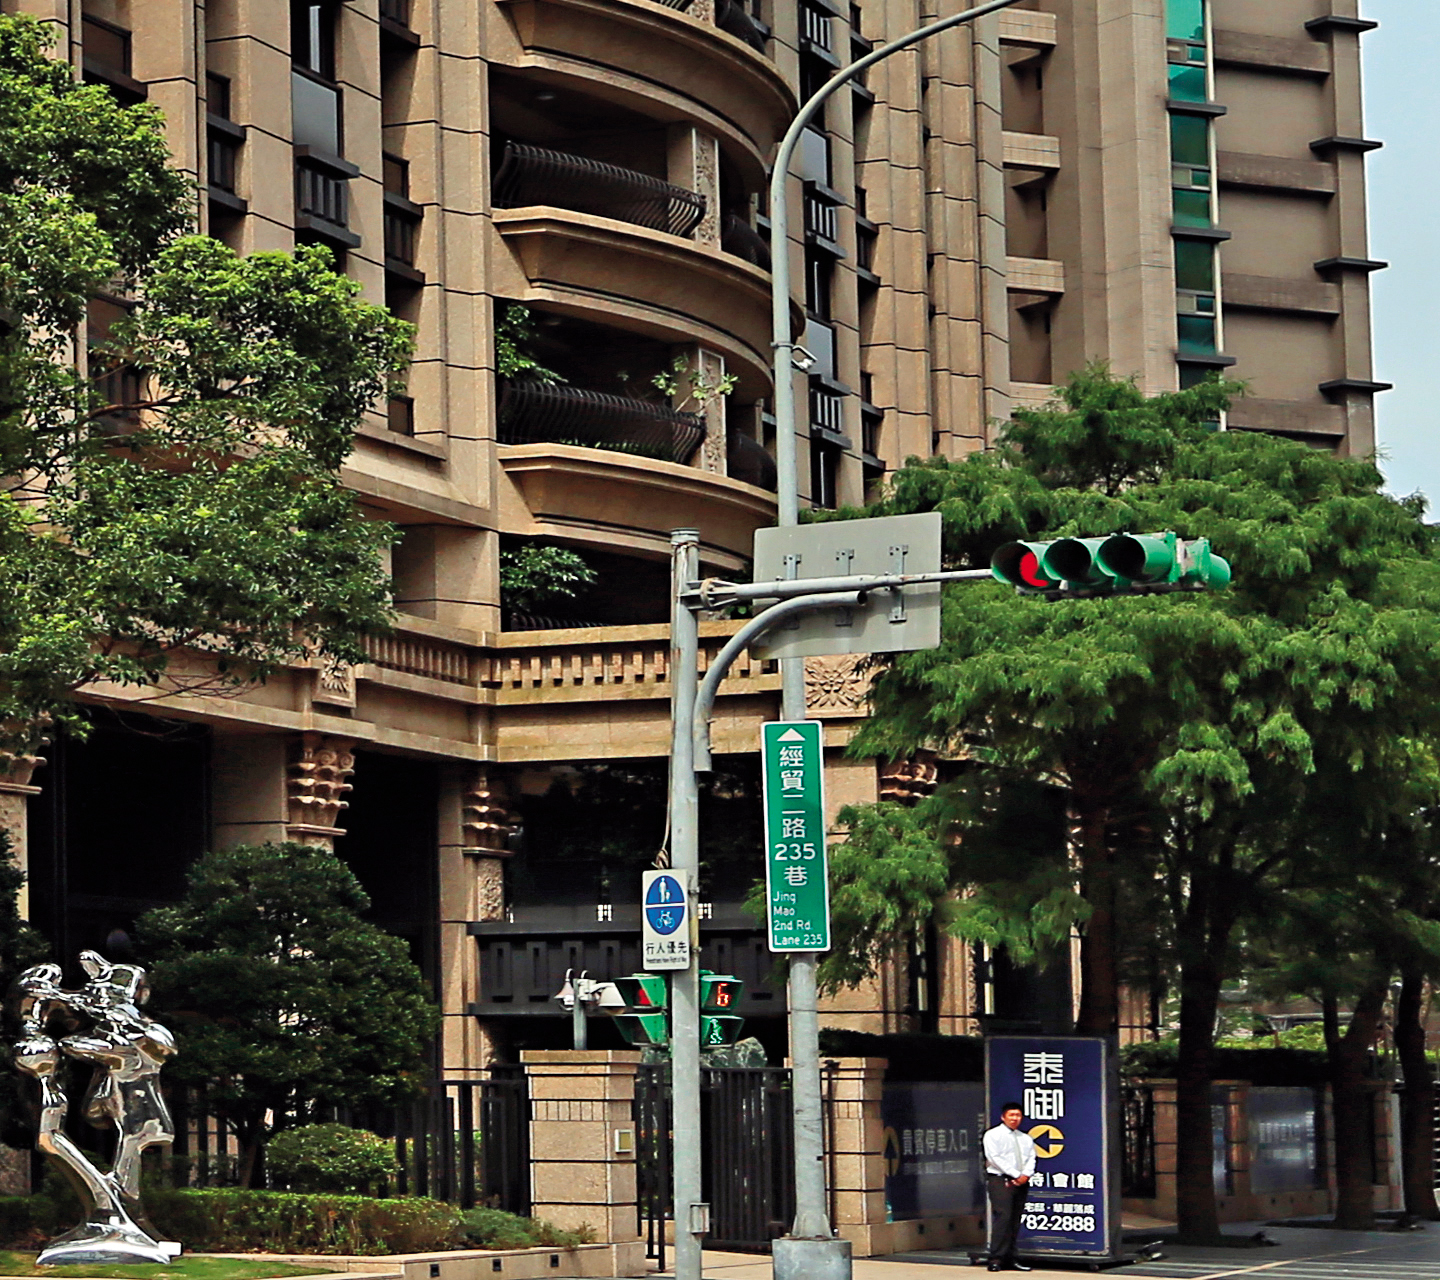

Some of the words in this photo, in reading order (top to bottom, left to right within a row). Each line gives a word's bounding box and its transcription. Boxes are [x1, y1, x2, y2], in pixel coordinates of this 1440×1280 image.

[772, 890, 797, 904] Jing
[773, 905, 796, 917] Mao
[773, 919, 794, 931] 2nd
[773, 934, 801, 946] Lane
[803, 933, 823, 945] 235
[646, 941, 688, 955] 行人優先
[717, 982, 730, 1007] 6
